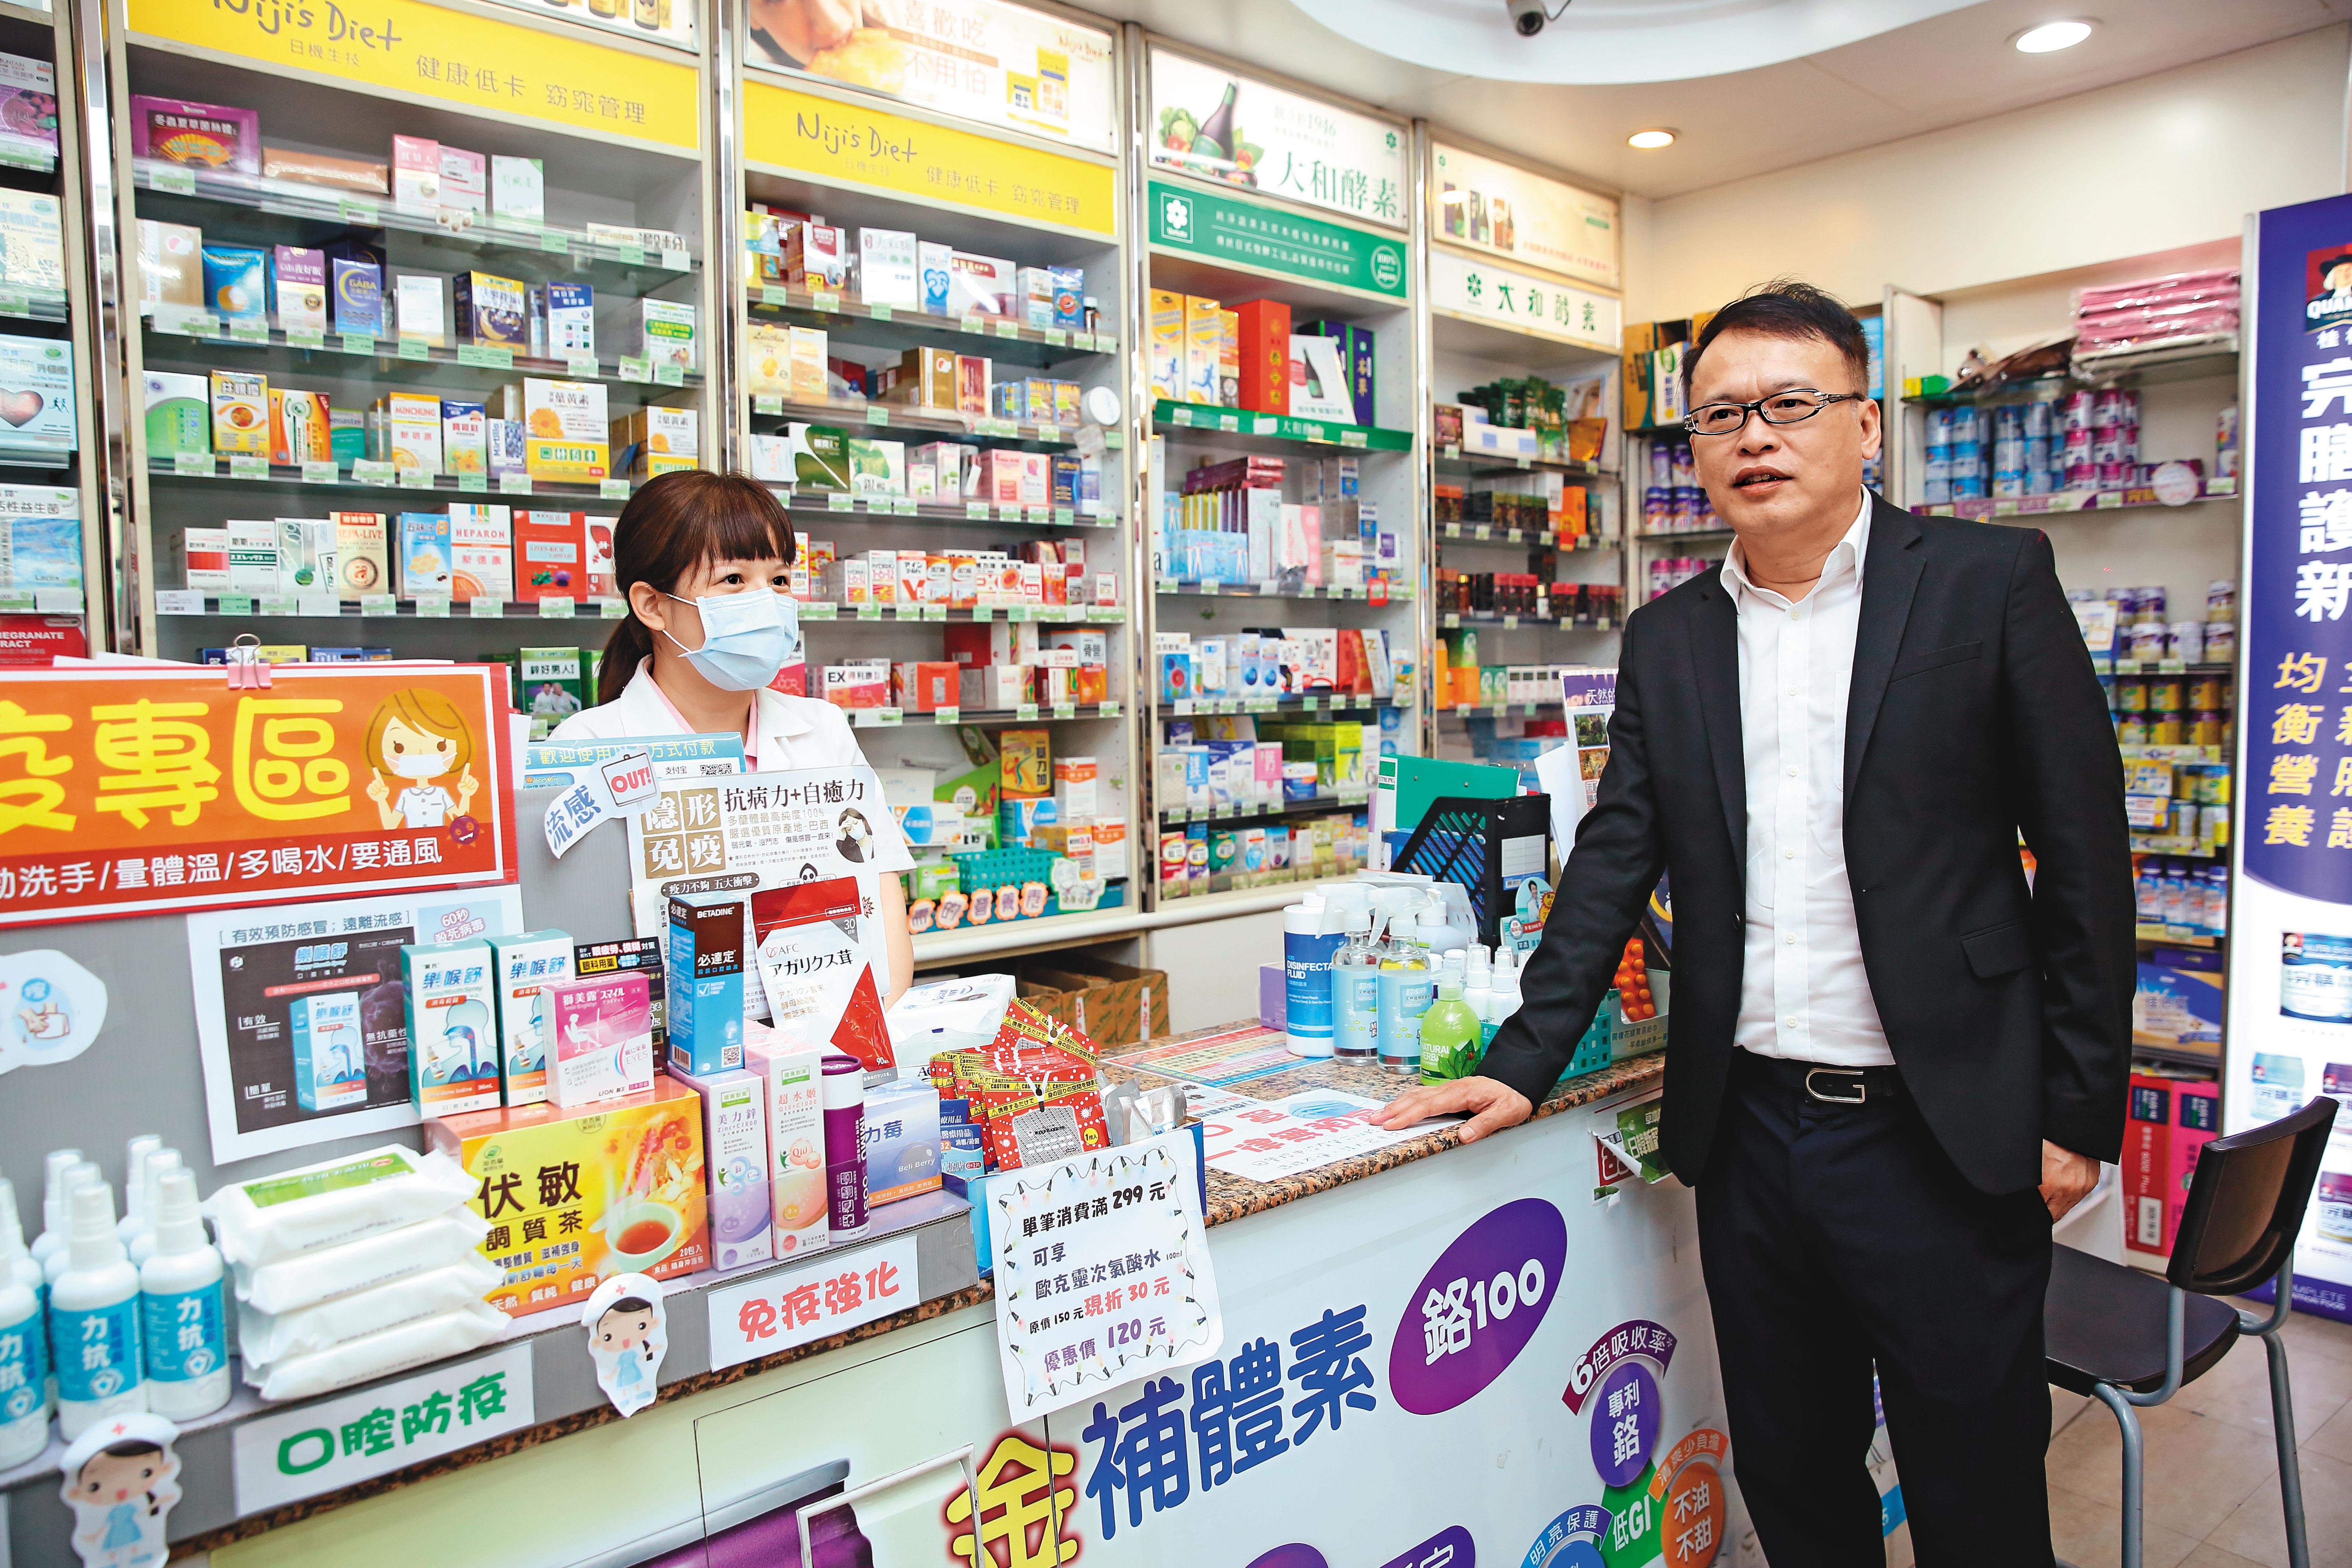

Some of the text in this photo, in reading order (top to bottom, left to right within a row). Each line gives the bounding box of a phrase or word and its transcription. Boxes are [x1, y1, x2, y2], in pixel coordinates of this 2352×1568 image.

[328, 1, 402, 51] Diet
[903, 0, 987, 48] 喜歡吃
[290, 39, 360, 67] 日機生技
[904, 51, 987, 96] 不用怕
[416, 55, 646, 125] 健康低卡 窈窕管理
[797, 111, 917, 163] Niji's Diet
[927, 165, 1080, 215] 健康低卡 窈窕管理
[1278, 151, 1398, 219] 大和酵素
[1498, 280, 1596, 331] 大和酵素
[456, 529, 505, 539] HEPARON
[828, 671, 846, 682] EX
[540, 741, 717, 765] 歡迎使用方式付款
[2264, 652, 2327, 847] 均衡營養
[611, 767, 652, 793] OUT!
[665, 766, 687, 775] 支付宝
[724, 779, 864, 812] 抗病力+自癒力
[547, 785, 601, 851] 流感
[646, 791, 718, 832] 隱形
[728, 808, 824, 826] 多醣體最高純度100%
[730, 820, 829, 839] 嚴選優質原產地-巴西
[648, 832, 723, 875] 免疫
[714, 875, 753, 889] 五大衝擊
[441, 907, 468, 927] 60秒
[697, 907, 733, 919] BETADINE
[844, 918, 855, 930] 30
[435, 919, 485, 942] 殺死病毒
[697, 950, 735, 967] 必達定
[768, 949, 853, 978] アガリクス茸
[778, 944, 800, 956] AFC
[422, 966, 483, 990] 樂喉舒
[510, 956, 567, 980] 樂喉舒
[1287, 970, 1306, 980] FLUID
[563, 987, 625, 1006] 獅美露 スマイル
[1017, 997, 1035, 1014] CAUTION
[243, 1013, 267, 1027] 有效
[1011, 1019, 1047, 1040] 携帯するだけで
[366, 1027, 408, 1043] 無抗藥性
[626, 1051, 648, 1064] EYES
[598, 1088, 615, 1097] LION
[779, 1087, 817, 1105] 超水姬
[779, 1099, 817, 1113] Q10+C1000
[717, 1108, 757, 1125] 美力鋅
[997, 1098, 1035, 1117] 携帯するだけで
[717, 1120, 757, 1133] Zinc+C1000
[1085, 1133, 1098, 1142] 1枚入
[793, 1147, 808, 1158] Q10
[898, 1156, 936, 1173] Beli Berry
[478, 1161, 584, 1219] 伏敏
[1022, 1181, 1167, 1238] 單筆消費滿 299 元
[486, 1209, 584, 1253] 調質茶
[541, 1240, 580, 1260] 滋補強身
[680, 1246, 703, 1258] 20包入
[1032, 1241, 1066, 1267] 可享
[1035, 1248, 1183, 1302] 歐克靈次氯酸水 100ml
[492, 1295, 518, 1312] 天然
[571, 1275, 597, 1293] 健康
[737, 1260, 900, 1342] 免疫強化
[1029, 1276, 1171, 1336] 原價 150 元 現折 30 元
[177, 1295, 204, 1353] 力抗
[1422, 1258, 1546, 1366] 鉻100
[80, 1314, 112, 1372] 力抗
[1044, 1314, 1166, 1372] 優惠價 120 元
[1608, 1379, 1640, 1420] 專利
[276, 1370, 508, 1476] 口腔防疫
[1082, 1303, 1377, 1540] 補體素
[1612, 1417, 1641, 1469] 鉻
[947, 1438, 1078, 1568] 金
[1673, 1480, 1711, 1525] 不油
[1612, 1493, 1652, 1552] 低GI
[1529, 1510, 1599, 1567] 明亮保護
[1676, 1516, 1713, 1566] 不甜
